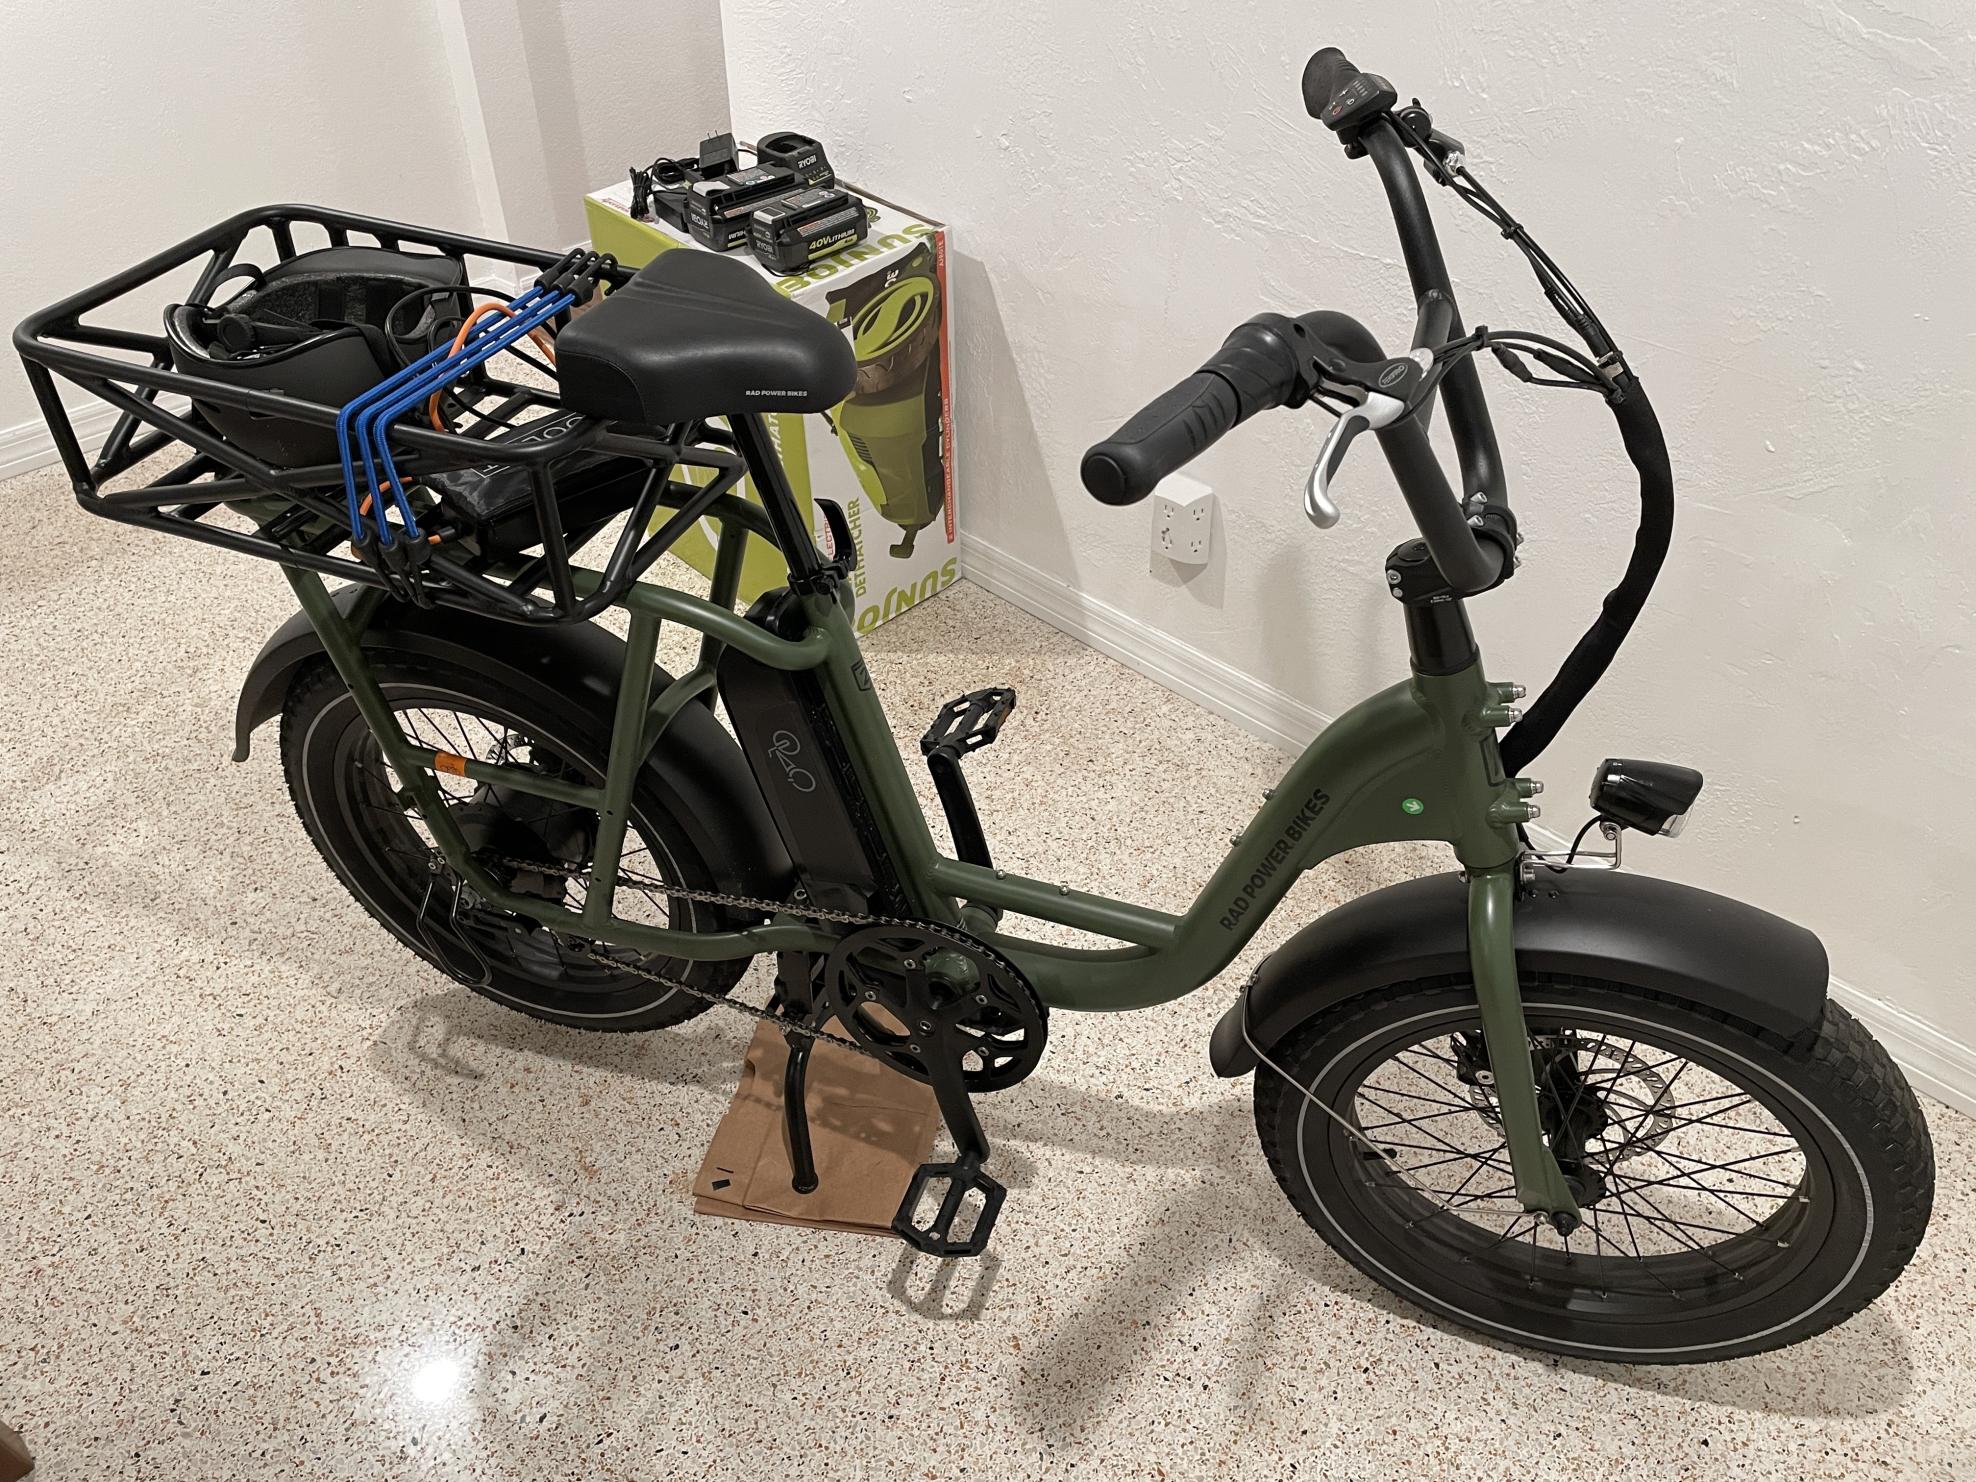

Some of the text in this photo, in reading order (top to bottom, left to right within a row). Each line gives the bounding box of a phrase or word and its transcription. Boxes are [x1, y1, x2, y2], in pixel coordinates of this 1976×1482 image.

[797, 154, 817, 169] RYOBI
[943, 398, 951, 449] CYLINDERS
[852, 556, 958, 635] SUNJO
[1219, 787, 1331, 931] RAD POWER BIKES
